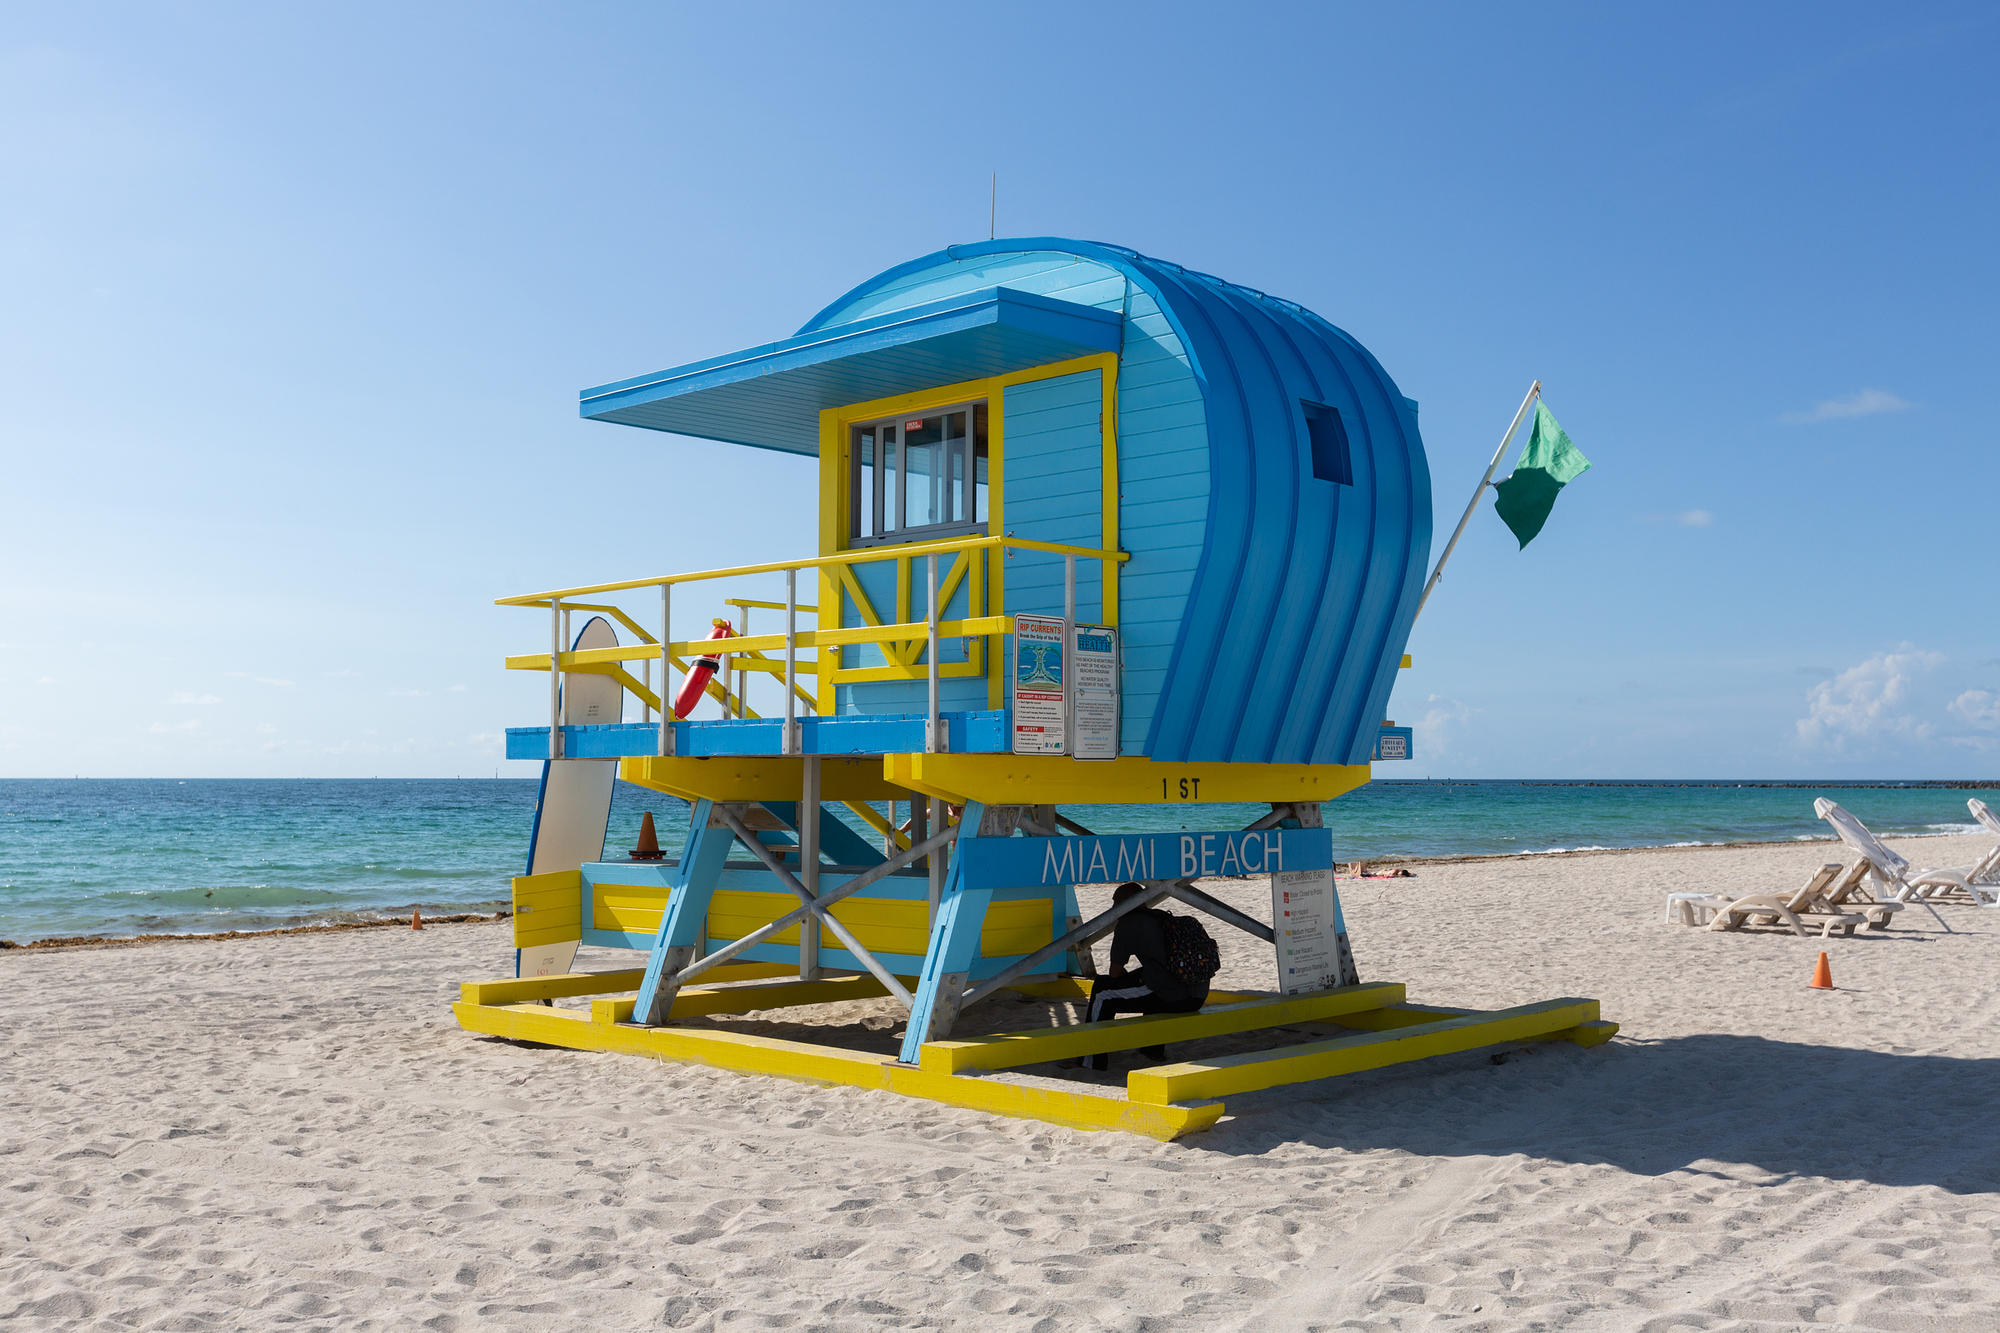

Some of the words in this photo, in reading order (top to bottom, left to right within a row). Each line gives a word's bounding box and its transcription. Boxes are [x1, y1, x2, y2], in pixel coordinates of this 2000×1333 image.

[1020, 622, 1030, 632] RIP
[1030, 624, 1062, 634] CURRENTS
[1079, 639, 1112, 652] HEALTH
[1162, 778, 1167, 800] 1
[1180, 778, 1200, 800] ST
[1042, 837, 1154, 884] MIAMI
[1180, 832, 1283, 877] BEACH
